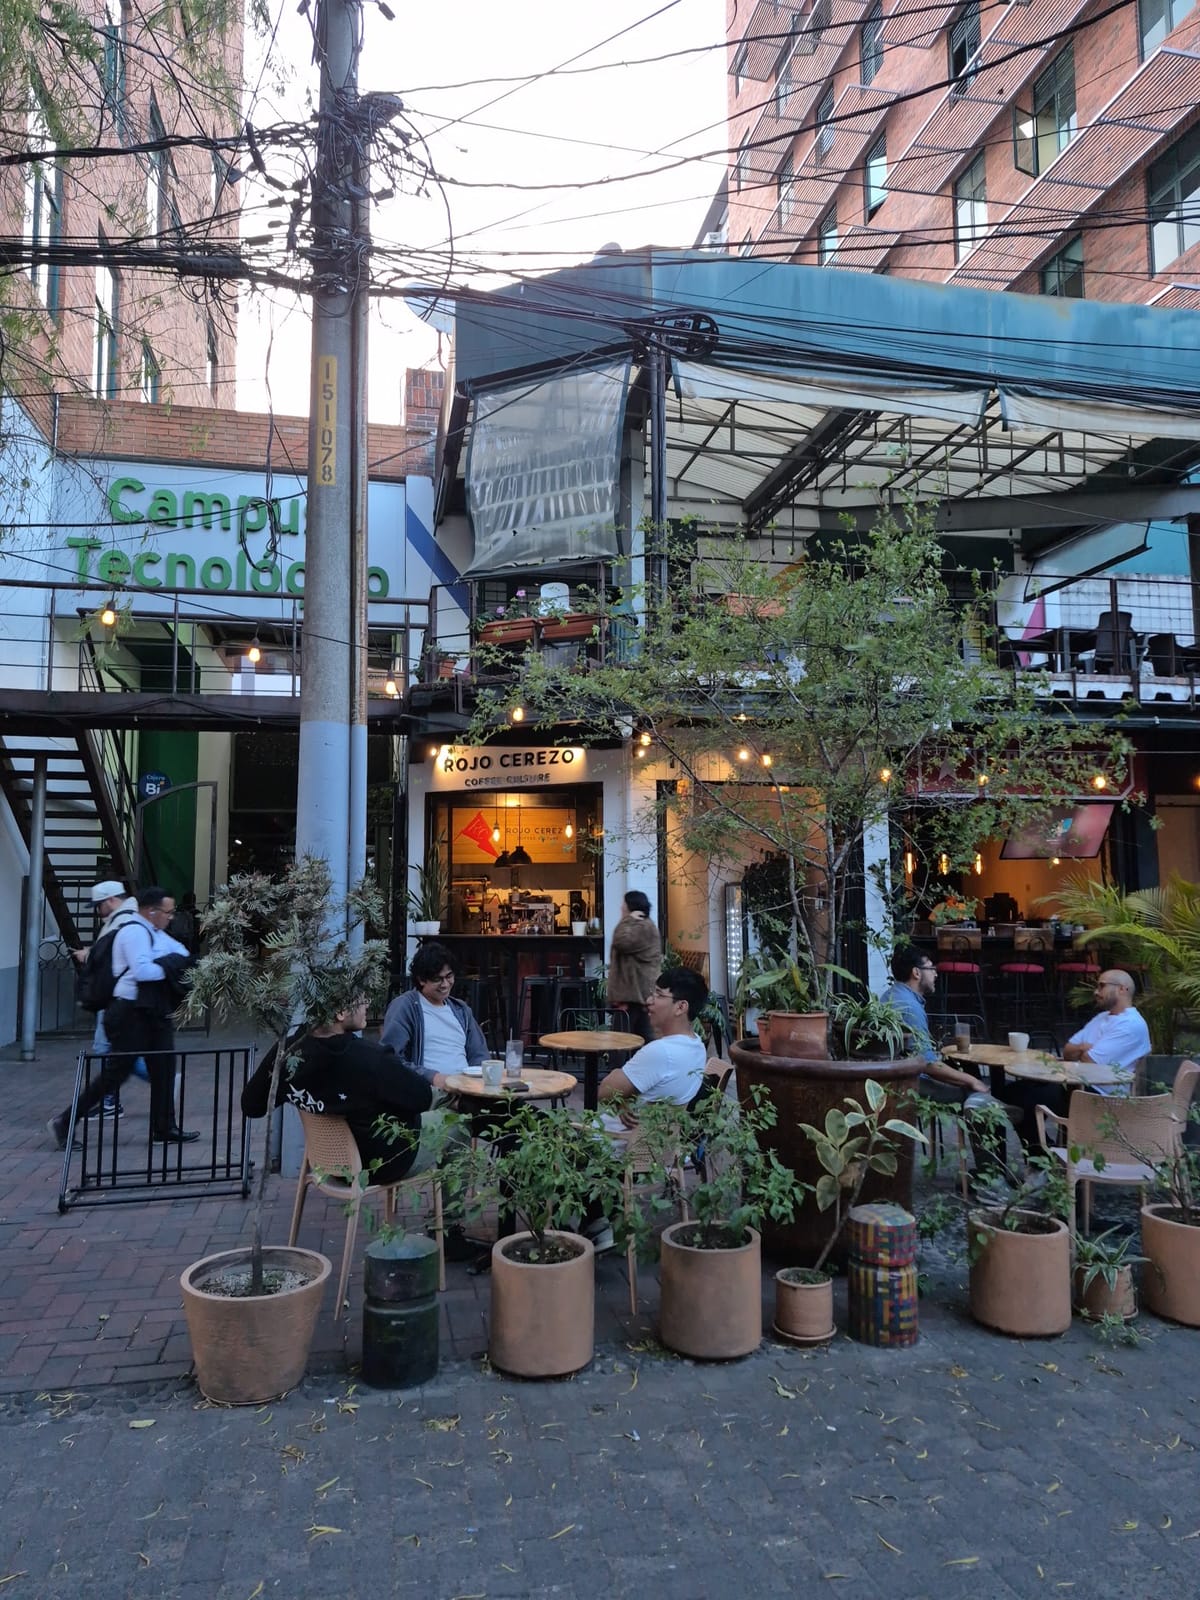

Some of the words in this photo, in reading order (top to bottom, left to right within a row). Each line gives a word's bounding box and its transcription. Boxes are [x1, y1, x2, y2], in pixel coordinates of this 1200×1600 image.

[321, 362, 334, 482] 151078
[107, 477, 308, 544] Campu
[67, 537, 389, 609] Tecnolóo
[146, 783, 161, 795] Bi
[444, 755, 491, 772] ROJO
[500, 750, 574, 767] CEREZO
